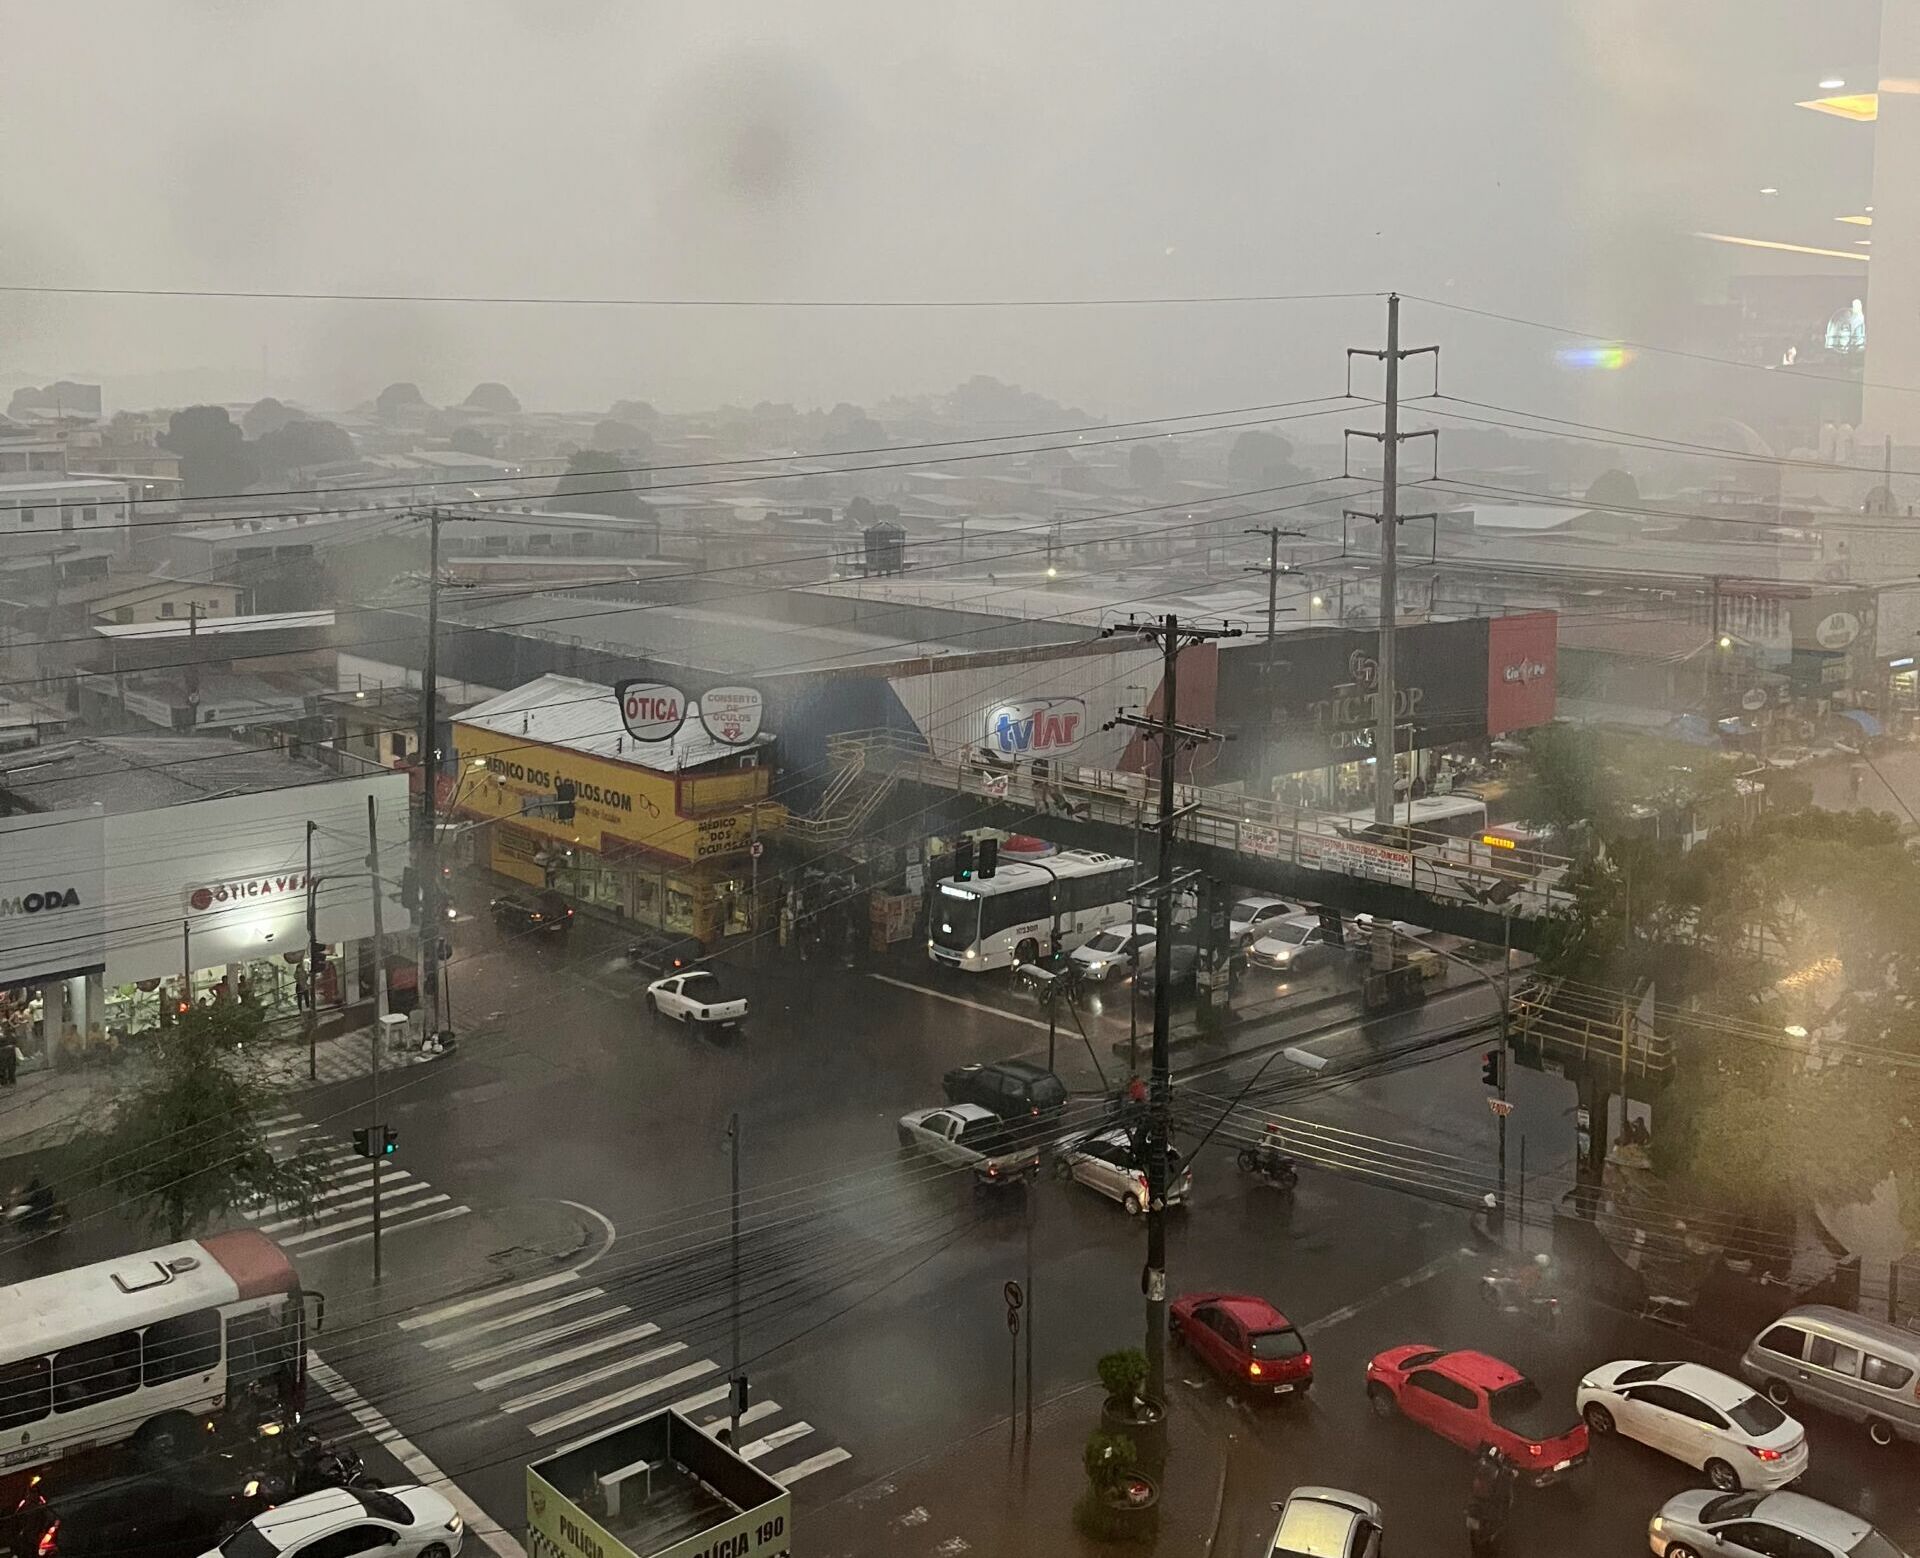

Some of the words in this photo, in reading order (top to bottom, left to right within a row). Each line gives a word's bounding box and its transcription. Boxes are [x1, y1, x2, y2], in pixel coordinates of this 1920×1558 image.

[626, 691, 679, 720] ÓTICA
[526, 767, 550, 788] DOS
[0, 887, 80, 917] MODA
[755, 1516, 784, 1546] 190
